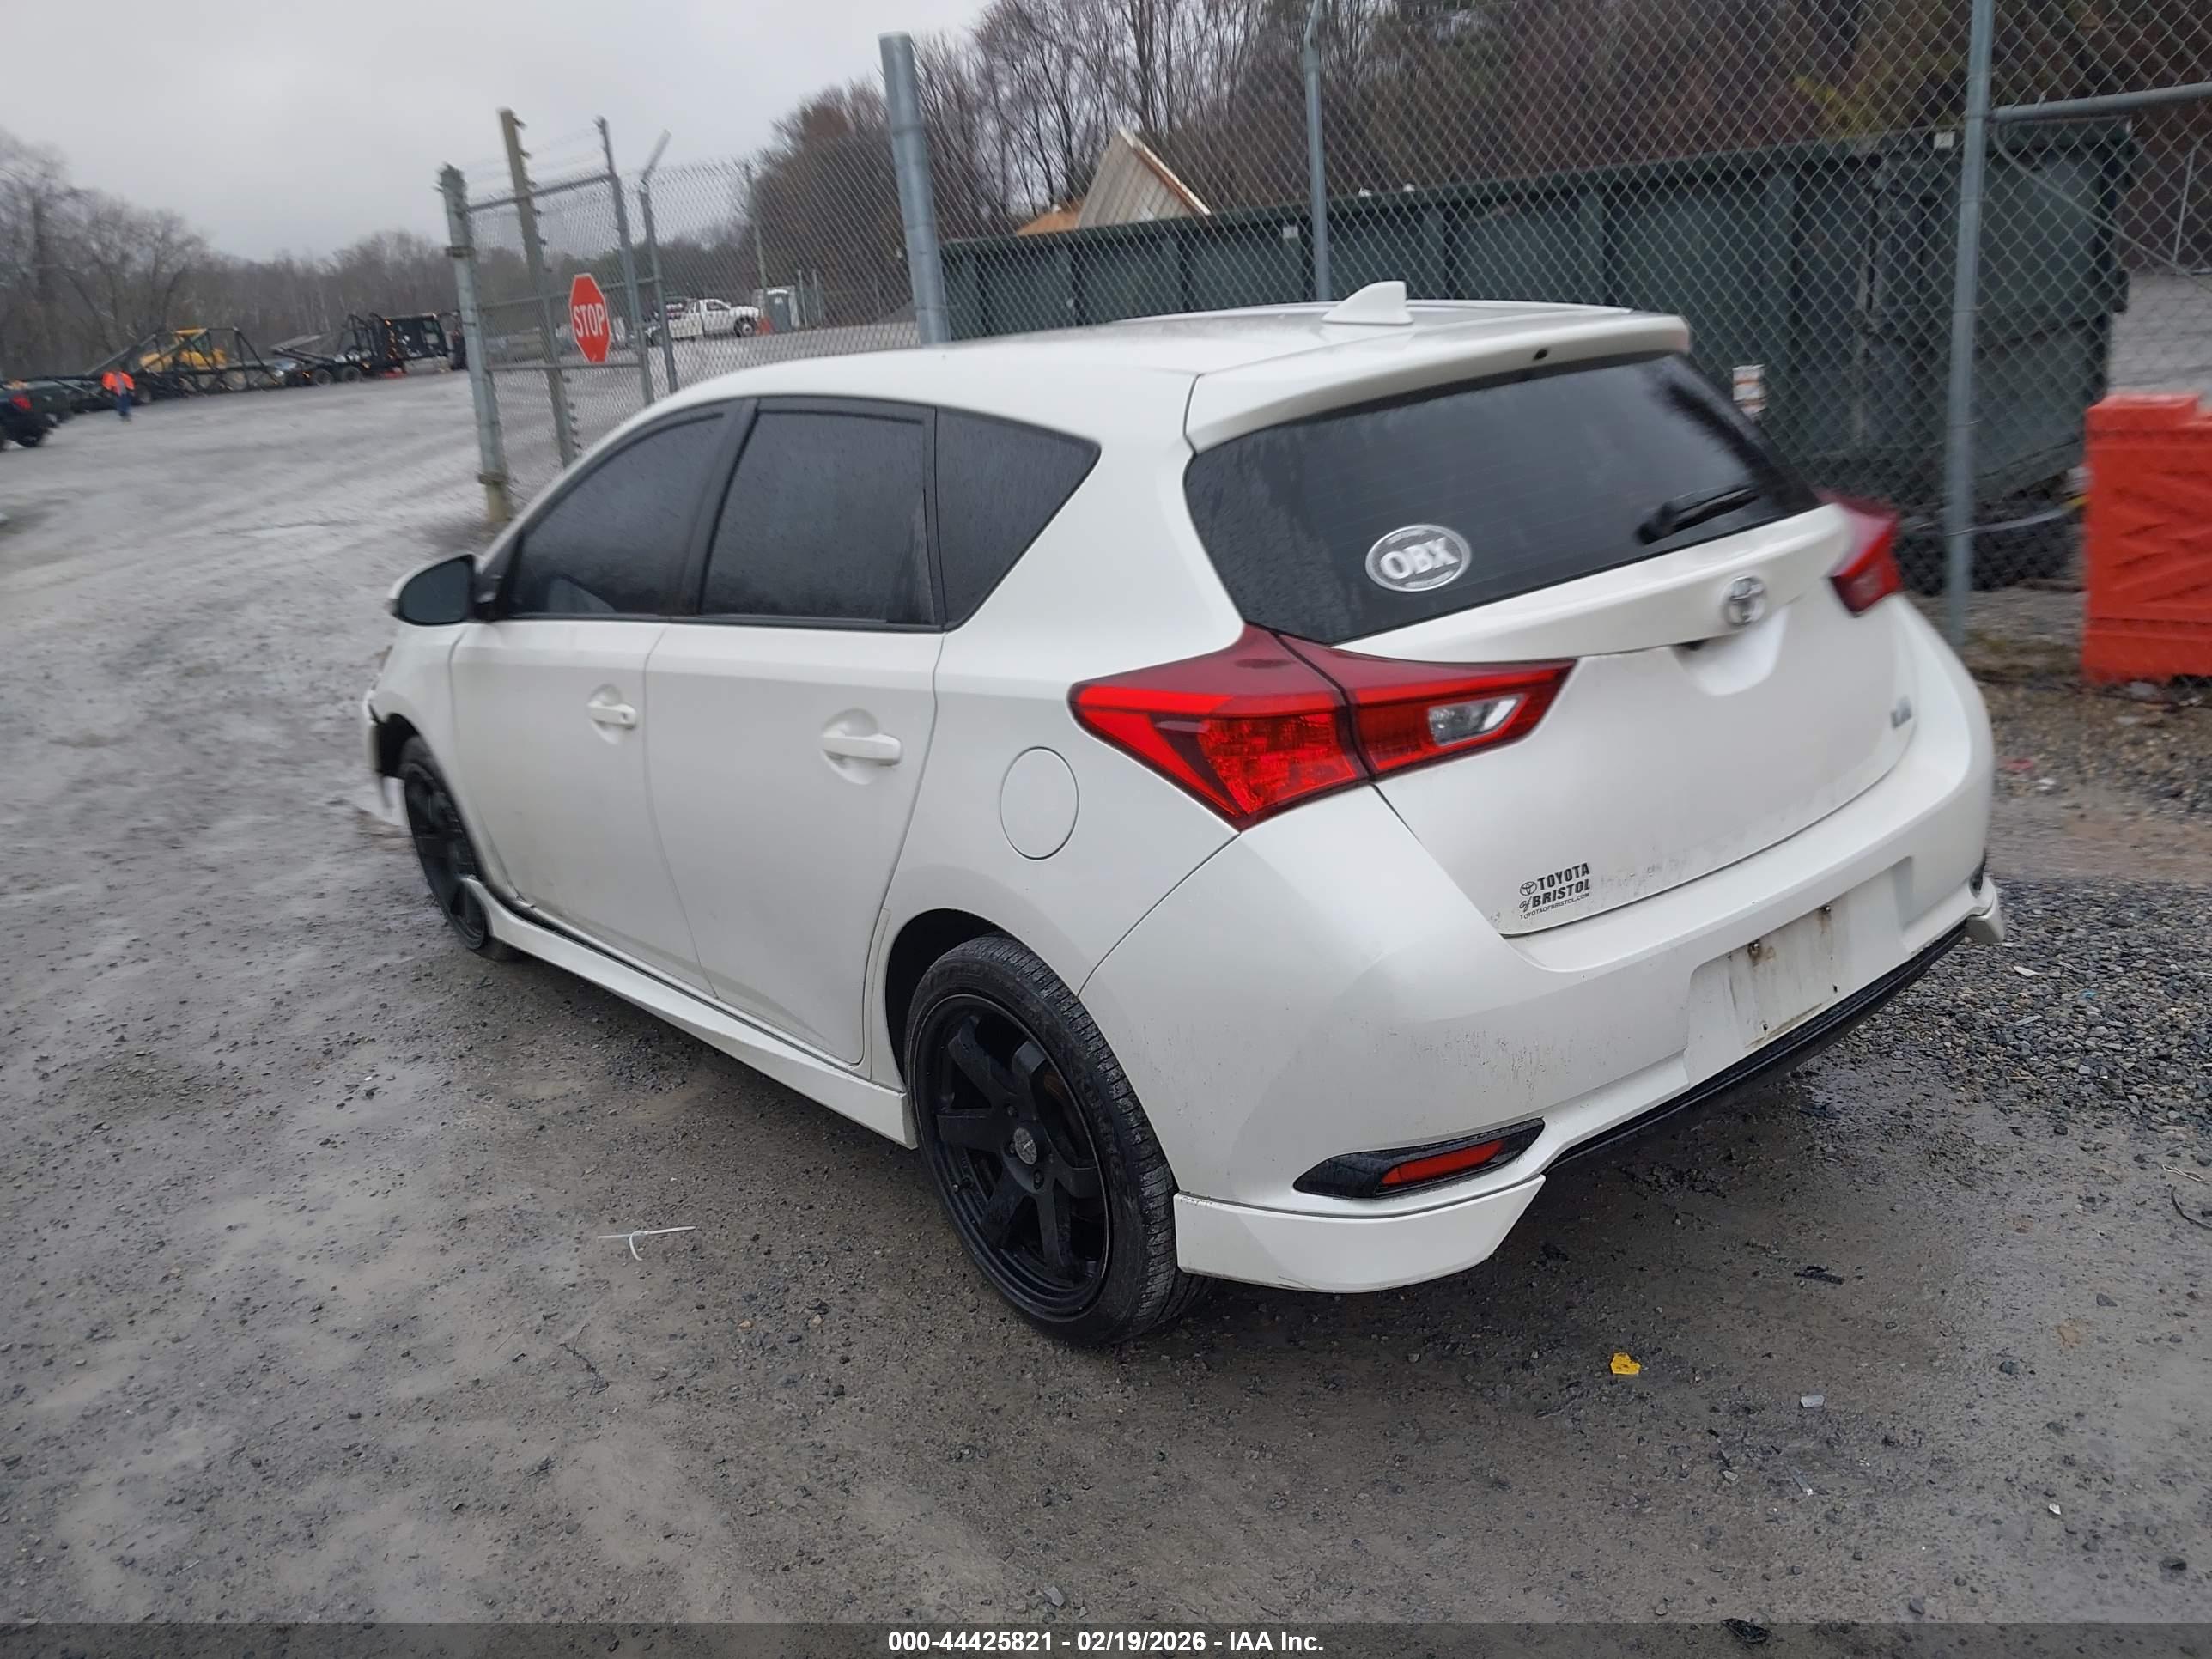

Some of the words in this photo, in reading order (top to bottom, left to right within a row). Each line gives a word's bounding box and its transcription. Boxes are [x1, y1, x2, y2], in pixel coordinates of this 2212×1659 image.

[573, 303, 605, 337] STOP
[1380, 537, 1460, 580] OBX
[1537, 862, 1590, 890] TOYOTA
[1532, 878, 1590, 908] BRISTOL
